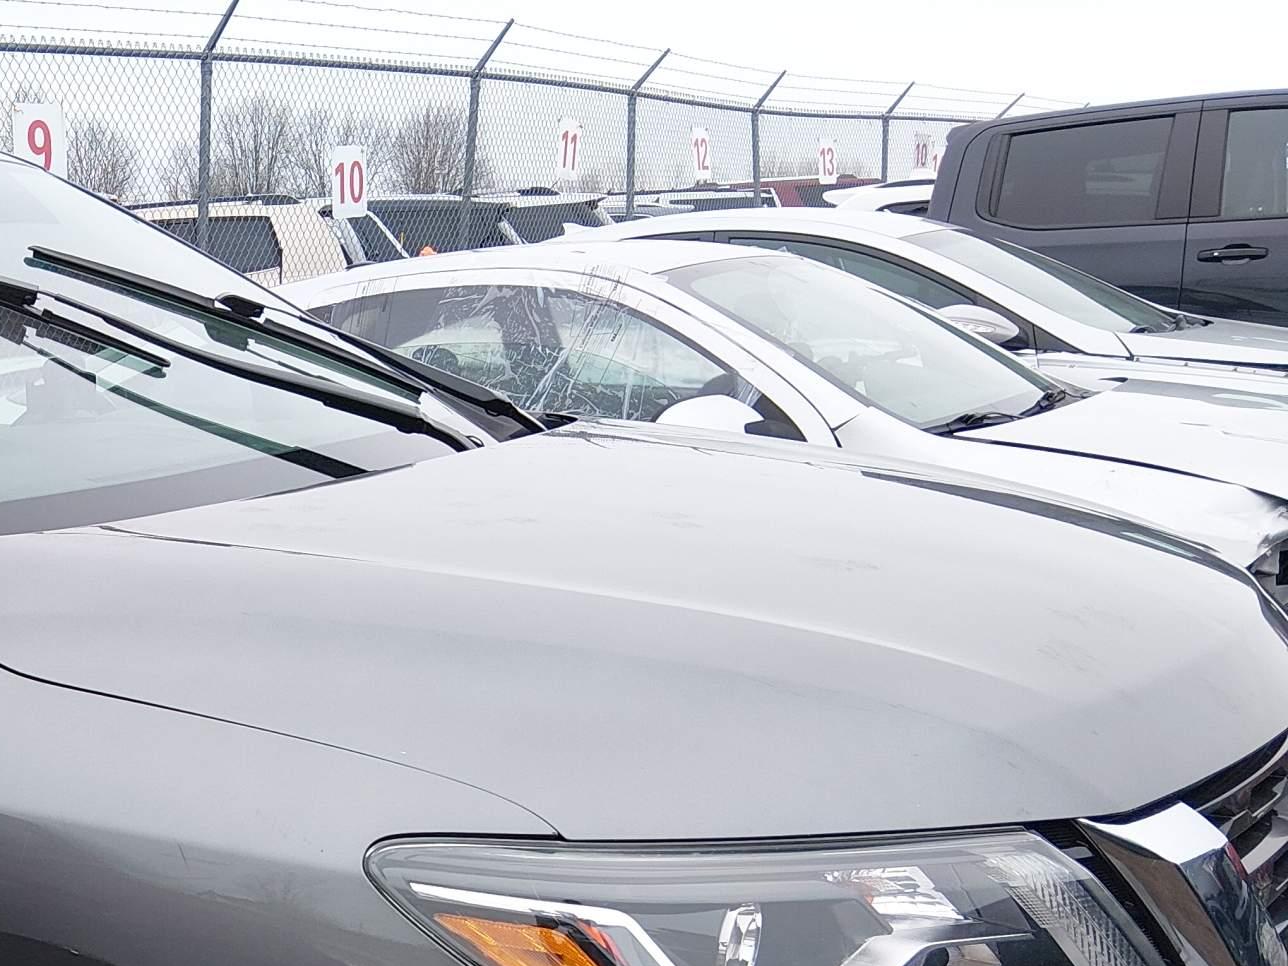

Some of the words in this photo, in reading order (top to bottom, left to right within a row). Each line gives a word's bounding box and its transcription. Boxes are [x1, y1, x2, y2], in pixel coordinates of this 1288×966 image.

[27, 119, 52, 172] 9
[561, 130, 578, 171] 11
[693, 137, 710, 171] 12
[819, 147, 835, 177] 13
[915, 142, 928, 168] 10
[334, 160, 364, 205] 10
